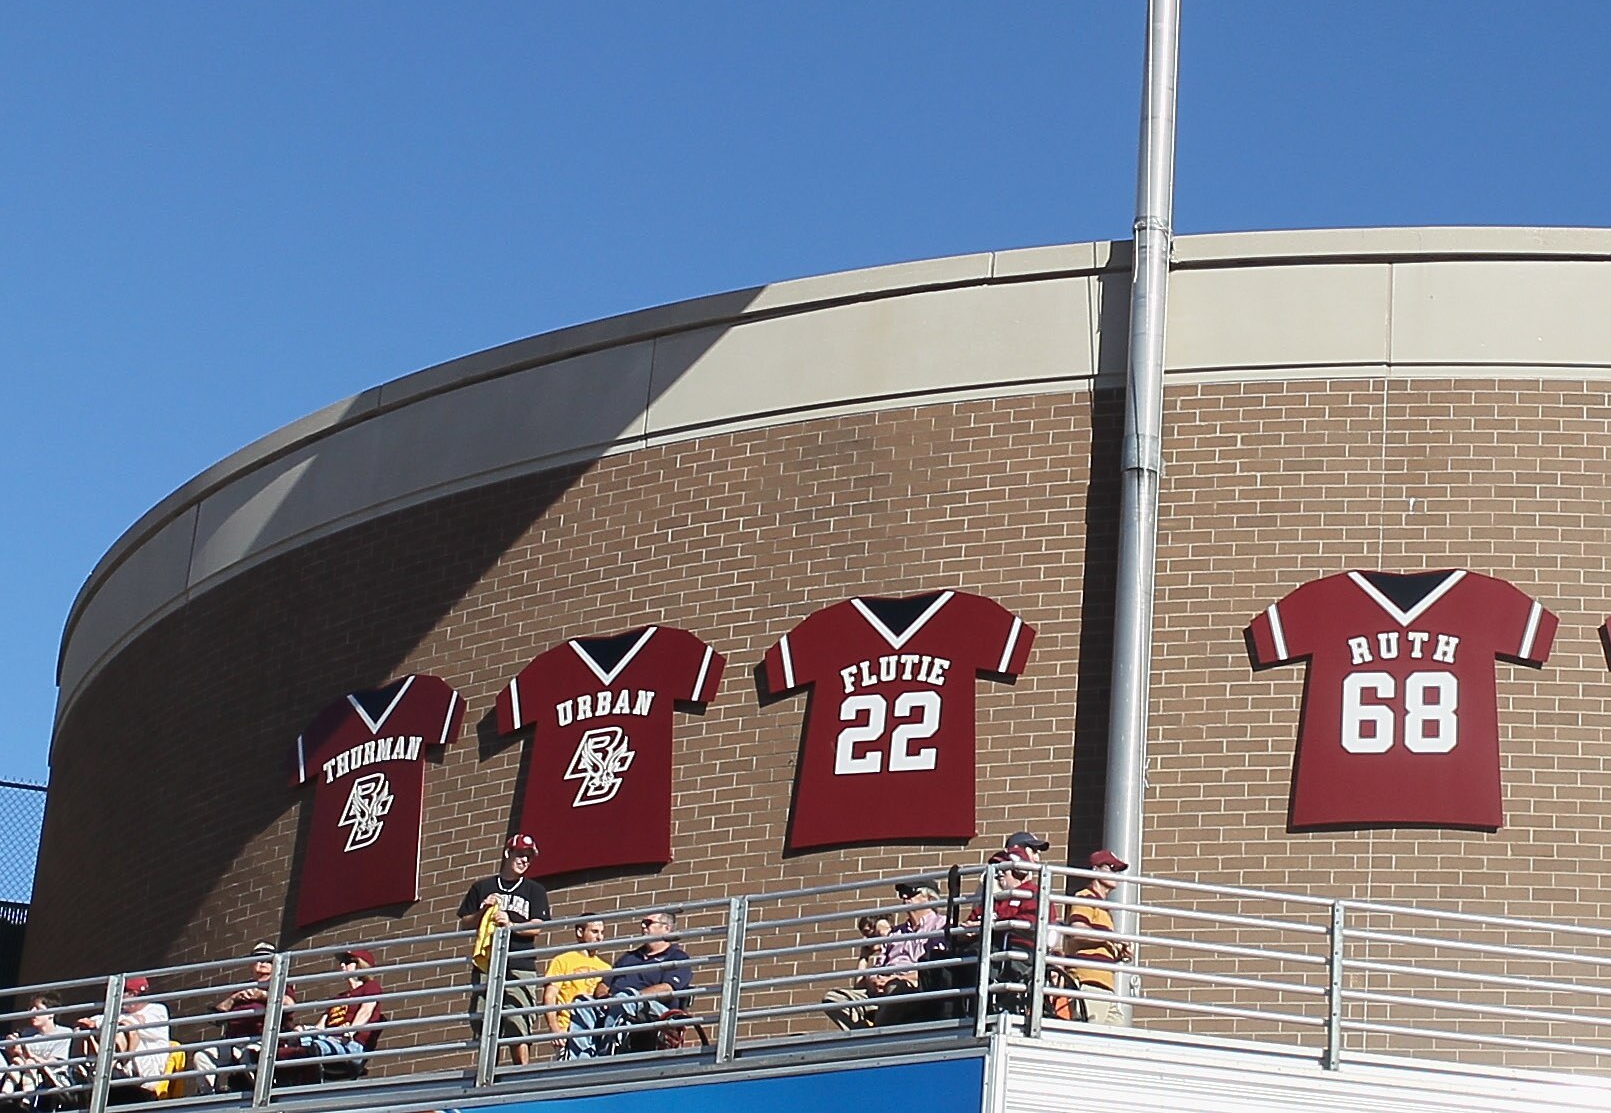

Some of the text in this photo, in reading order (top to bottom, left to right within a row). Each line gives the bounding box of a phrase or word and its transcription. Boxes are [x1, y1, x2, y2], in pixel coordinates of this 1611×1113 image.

[1348, 631, 1459, 665] RUTH
[840, 654, 950, 693] FLUTIE
[556, 690, 655, 727] URBAN
[1342, 671, 1458, 754] 68
[834, 689, 941, 774] 22
[322, 735, 423, 783] THURMAN
